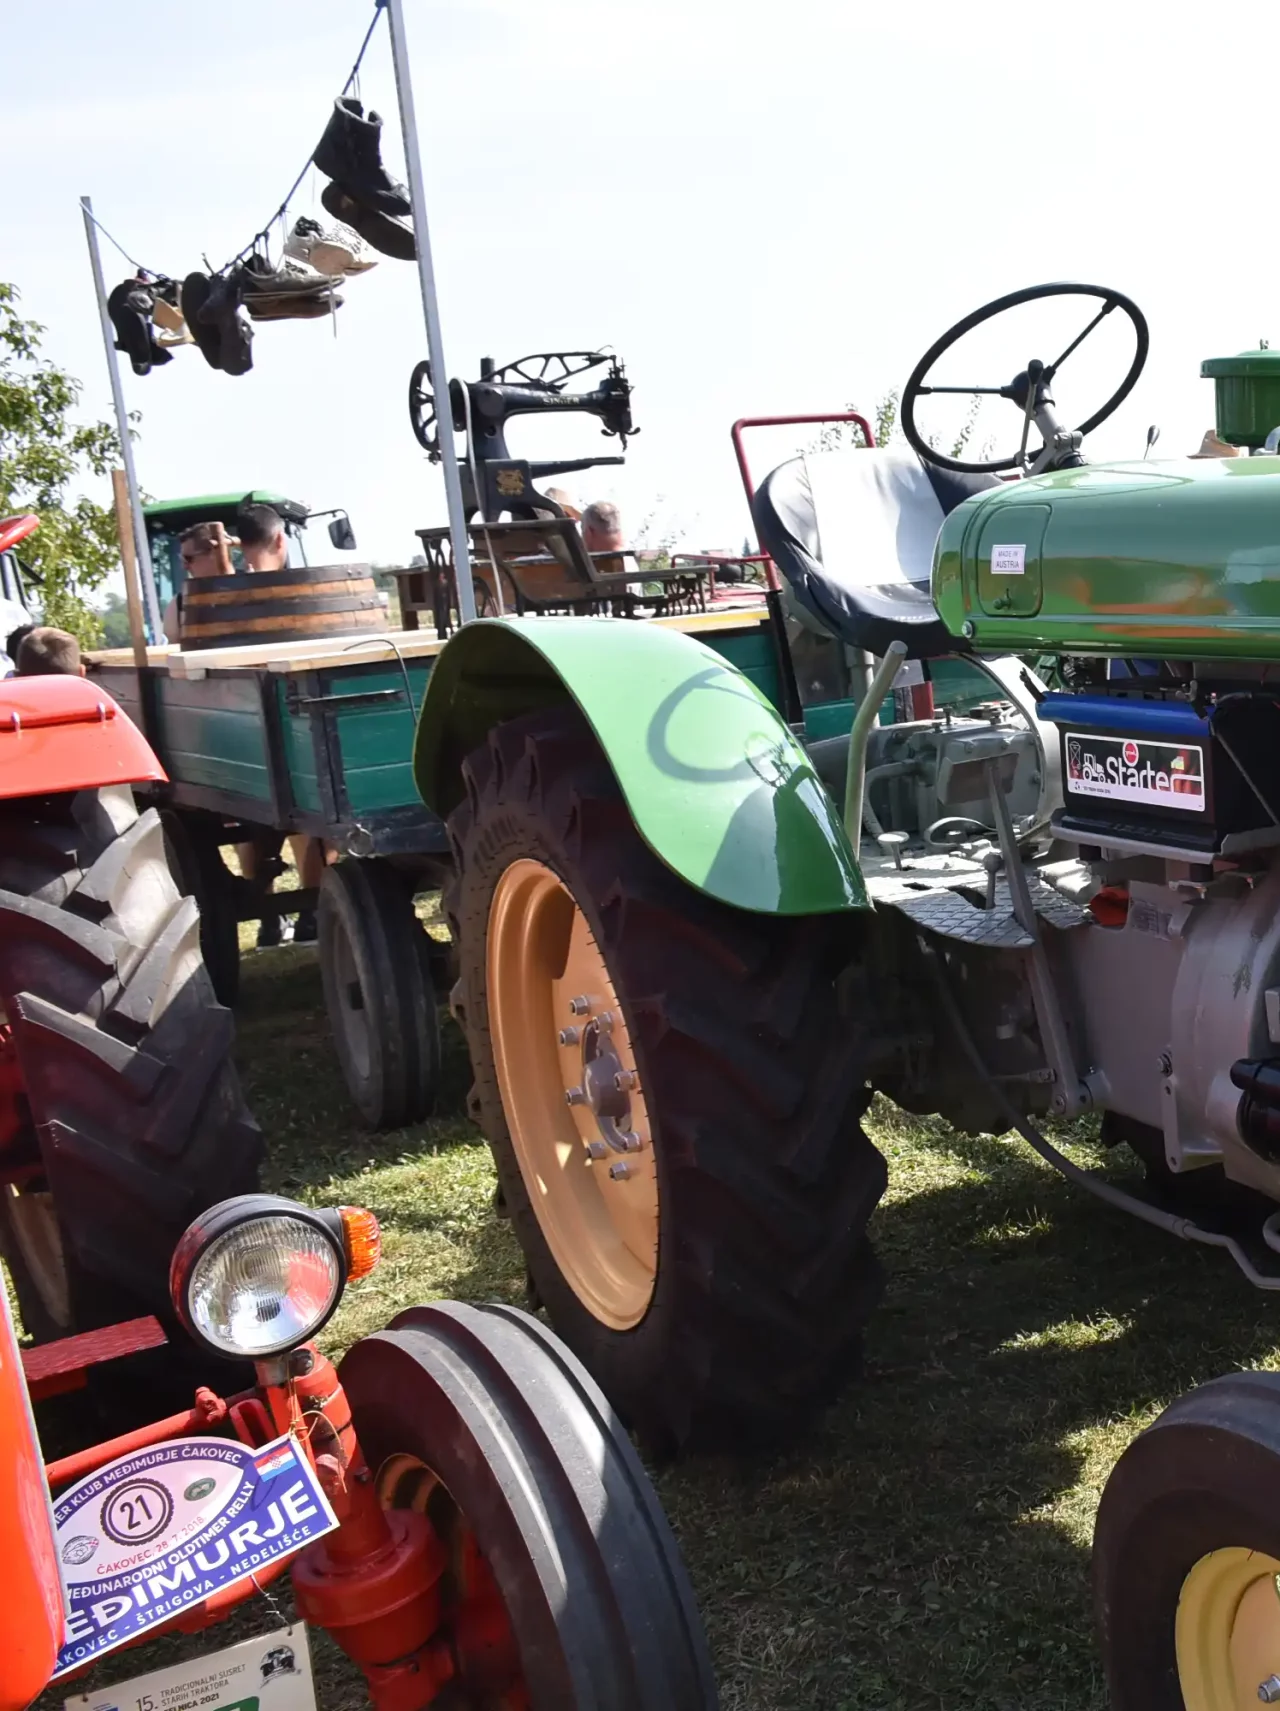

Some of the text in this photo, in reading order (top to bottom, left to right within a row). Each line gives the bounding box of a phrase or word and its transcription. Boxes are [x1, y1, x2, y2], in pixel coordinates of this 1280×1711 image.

[996, 560, 1019, 569] AUSTRIA
[70, 1481, 103, 1507] KLUB
[104, 1449, 178, 1485] MEĐIMURJE
[181, 1445, 242, 1464] ČAKOVEC
[120, 1494, 153, 1530] 21
[168, 1516, 230, 1565] OLDTIMER
[226, 1481, 255, 1517] RELLY
[65, 1480, 318, 1645] EĐIMURJE
[96, 1549, 155, 1575] ČAKOVEC,
[55, 1525, 312, 1669] AKOVEC ŠTRIGOVA NEDELIŠĆE
[160, 1664, 246, 1698] TRADICIONALNI SUSRET
[161, 1679, 229, 1706] STARIH TRAKTORA
[136, 1694, 158, 1711] 15.
[200, 1693, 219, 1704] 2021
